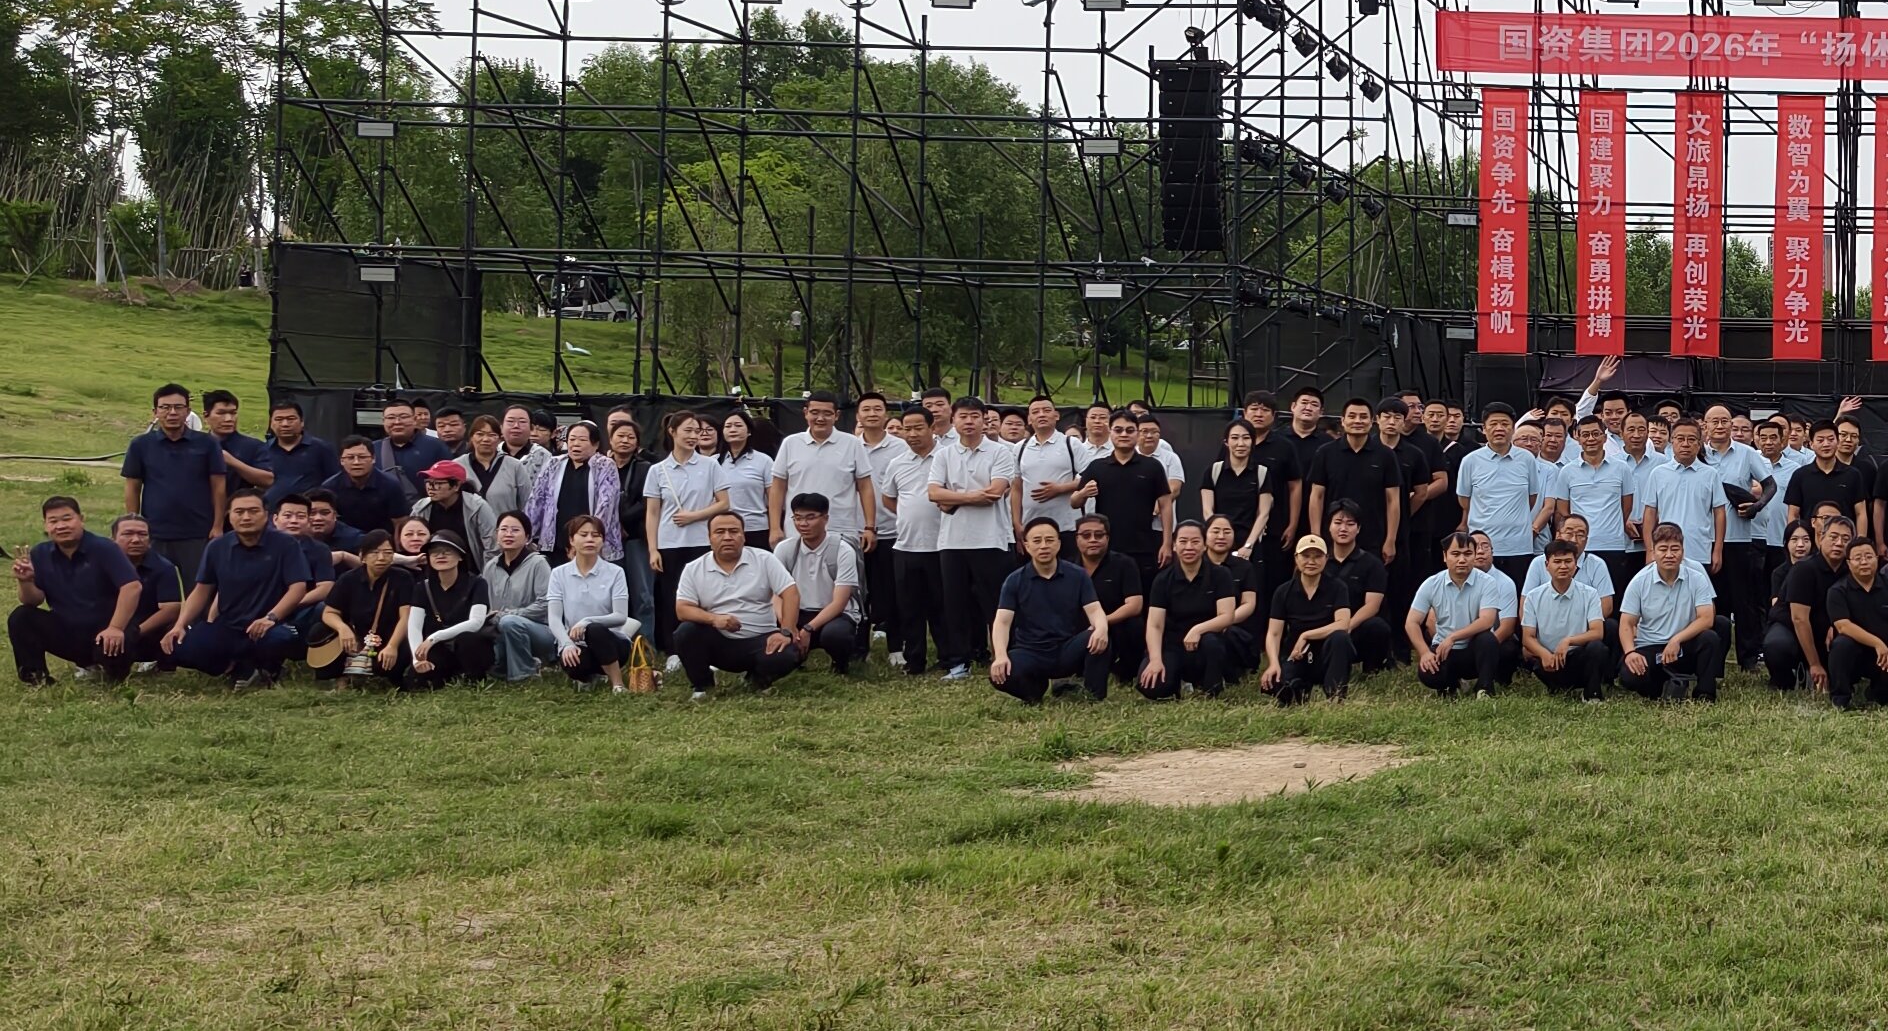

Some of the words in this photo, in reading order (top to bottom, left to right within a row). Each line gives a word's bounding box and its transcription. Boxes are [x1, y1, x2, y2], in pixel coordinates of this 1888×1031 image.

[1491, 108, 1516, 213] 国资争先
[1590, 109, 1613, 215] 国建聚力
[1686, 111, 1711, 217] 文旅昂扬
[1787, 114, 1812, 221] 数智为翼
[1490, 228, 1514, 333] 奋楫扬帆
[1587, 231, 1612, 337] 奋勇拼搏
[1683, 234, 1708, 339] 再创荣光
[1785, 237, 1810, 342] 聚力争光
